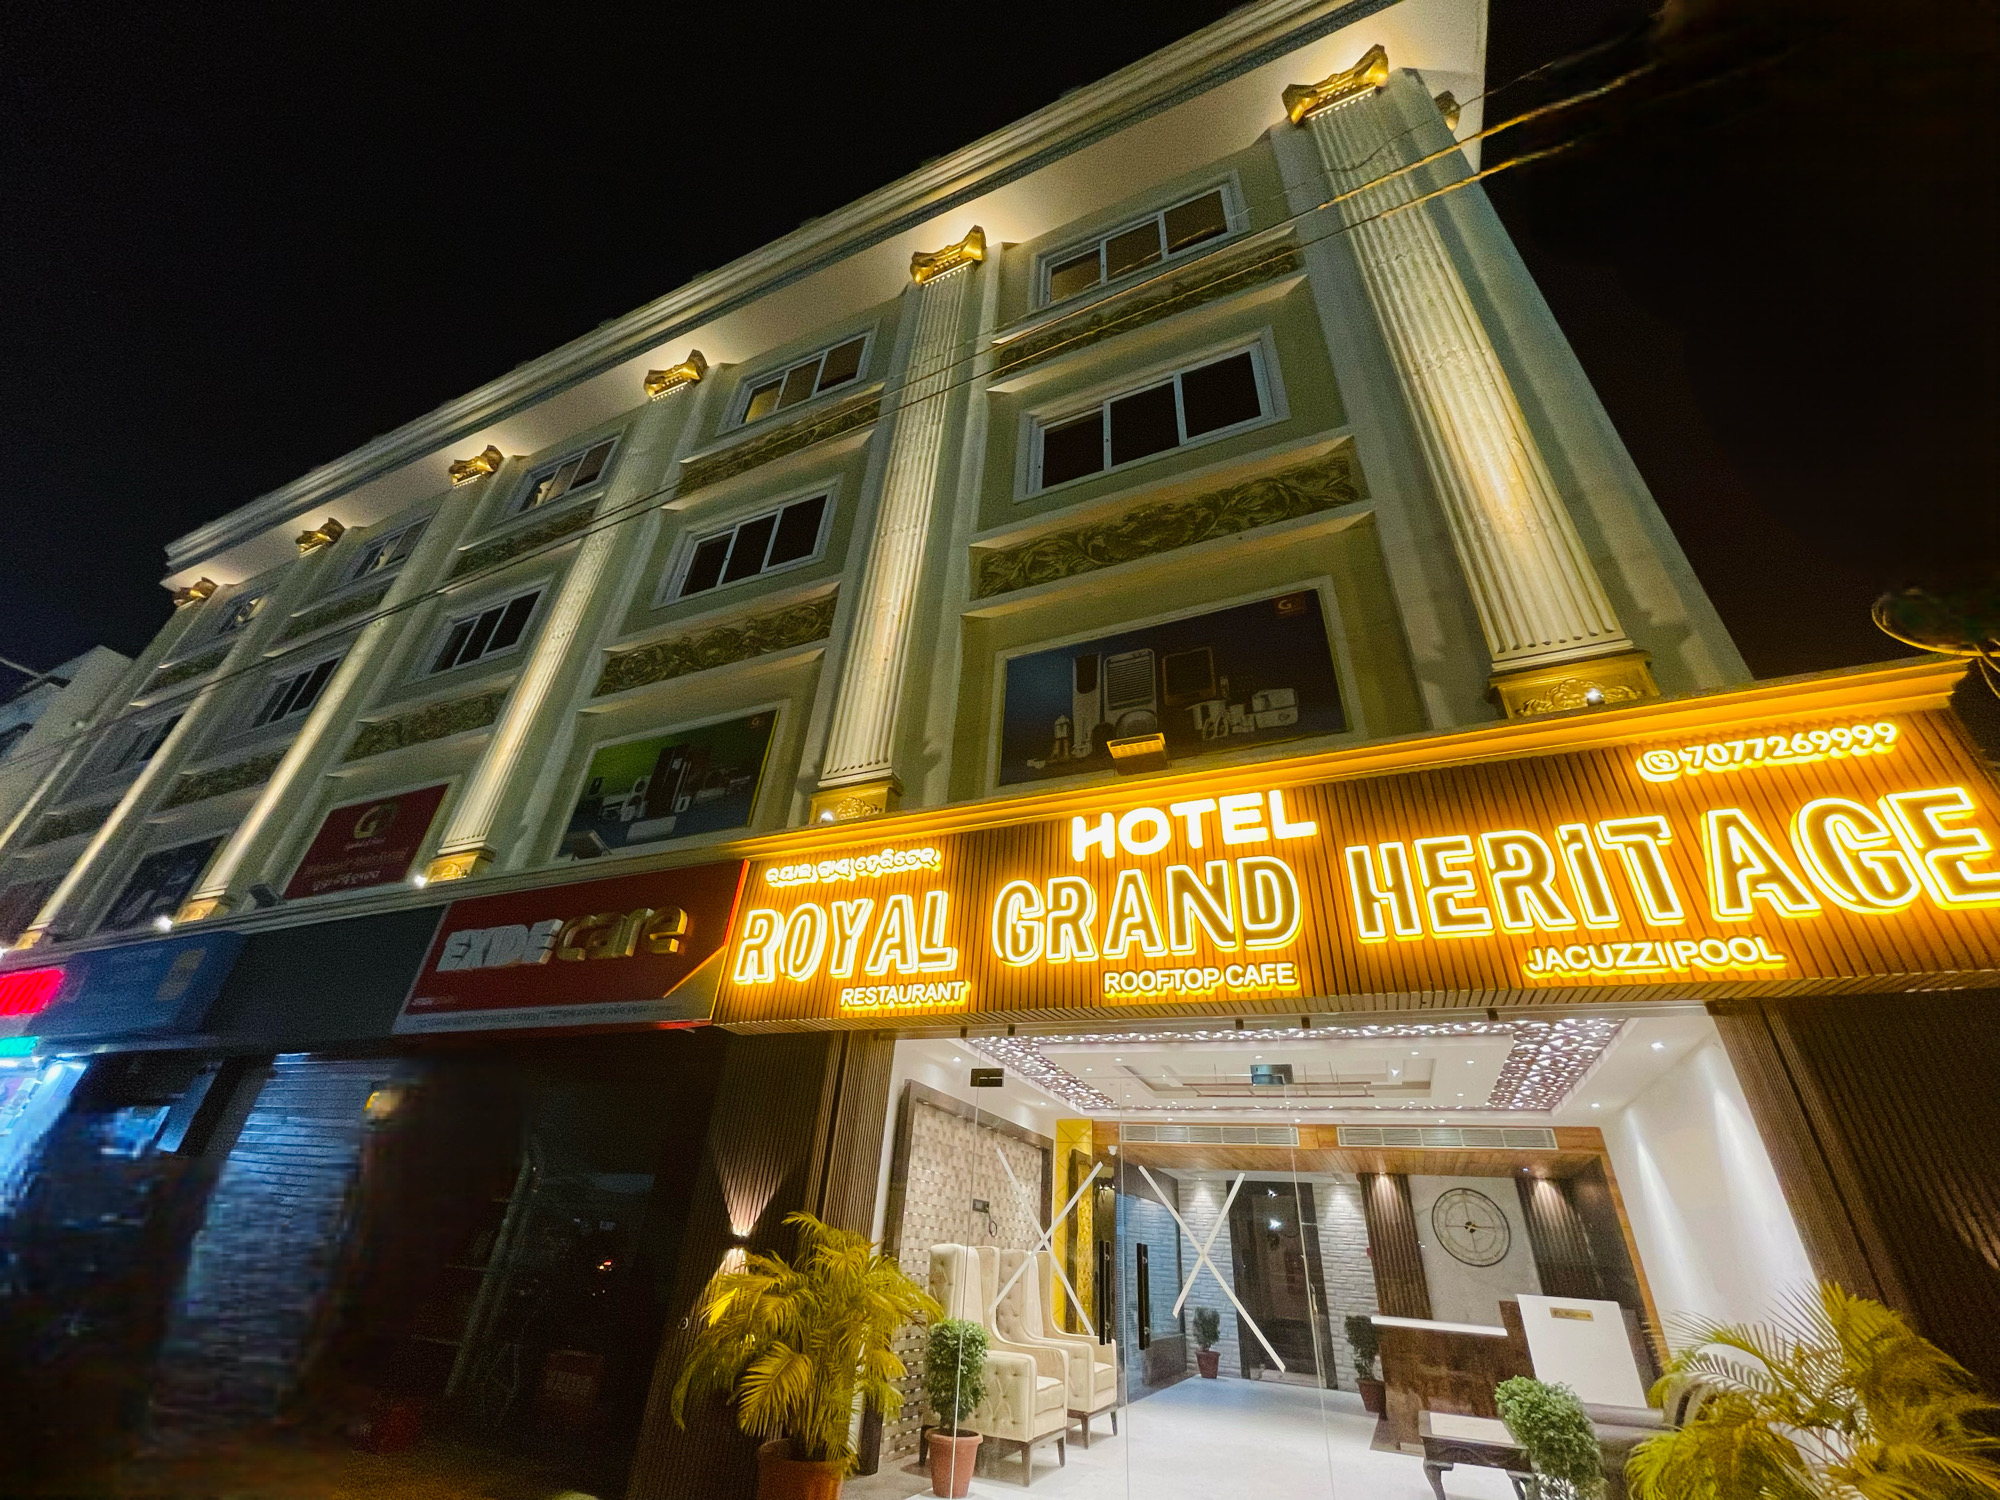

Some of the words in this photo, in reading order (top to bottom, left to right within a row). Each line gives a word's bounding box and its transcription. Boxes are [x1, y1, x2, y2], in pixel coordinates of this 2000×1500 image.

[1685, 722, 1896, 773] 7077269999
[1072, 789, 1317, 862] HOTEL
[734, 890, 957, 984] ROYAL
[992, 856, 1303, 967] GRAND
[841, 981, 968, 1009] RESTAURANT
[1104, 967, 1220, 996] ROOFTOP
[1225, 963, 1298, 991] CAFE
